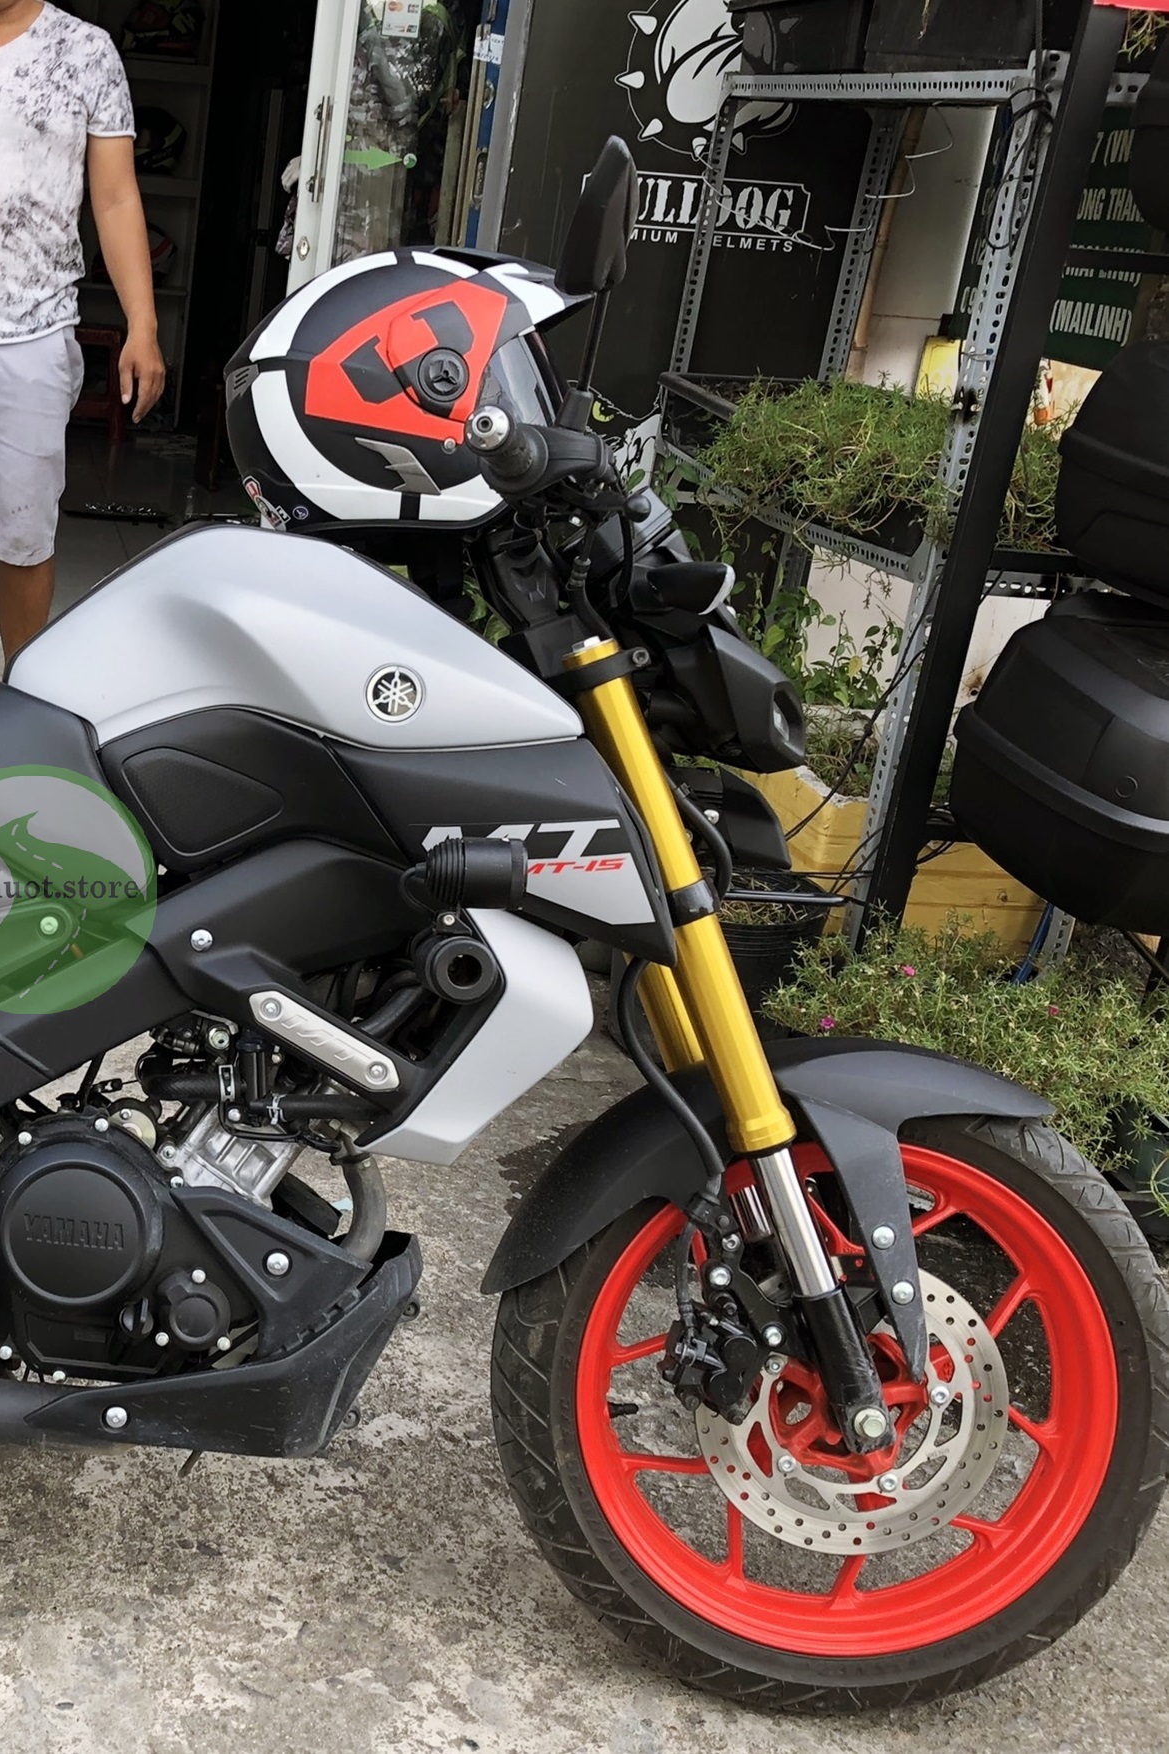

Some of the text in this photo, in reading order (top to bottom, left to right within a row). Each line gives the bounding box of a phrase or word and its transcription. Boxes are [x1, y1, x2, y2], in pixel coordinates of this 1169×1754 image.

[711, 235, 794, 253] ELMETS
[1049, 299, 1133, 348] (MAILINH)
[24, 1213, 125, 1250] YAMAHA
